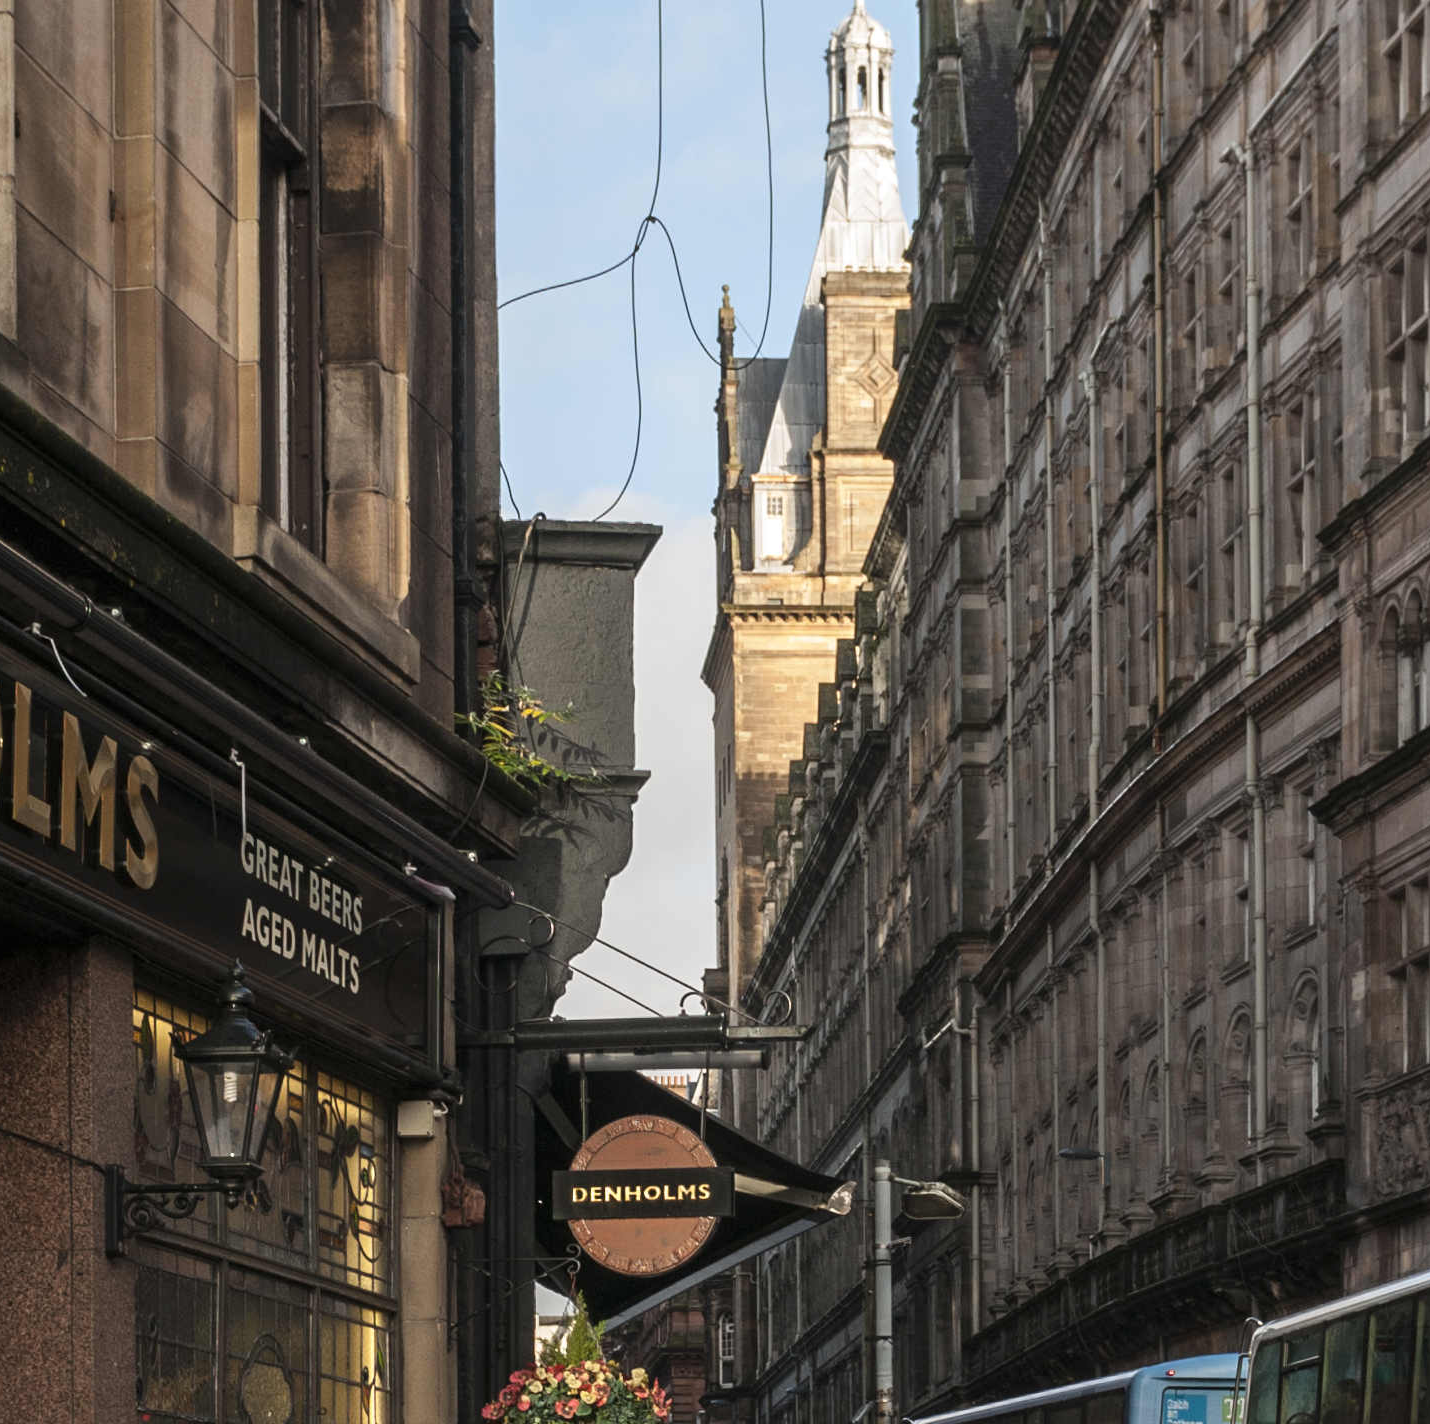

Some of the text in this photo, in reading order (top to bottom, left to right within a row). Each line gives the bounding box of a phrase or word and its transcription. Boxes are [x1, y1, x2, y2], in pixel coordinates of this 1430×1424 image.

[240, 830, 364, 937] GREAT BEERS
[241, 896, 361, 997] AGED MALTS
[571, 1182, 711, 1204] DENHOLMS
